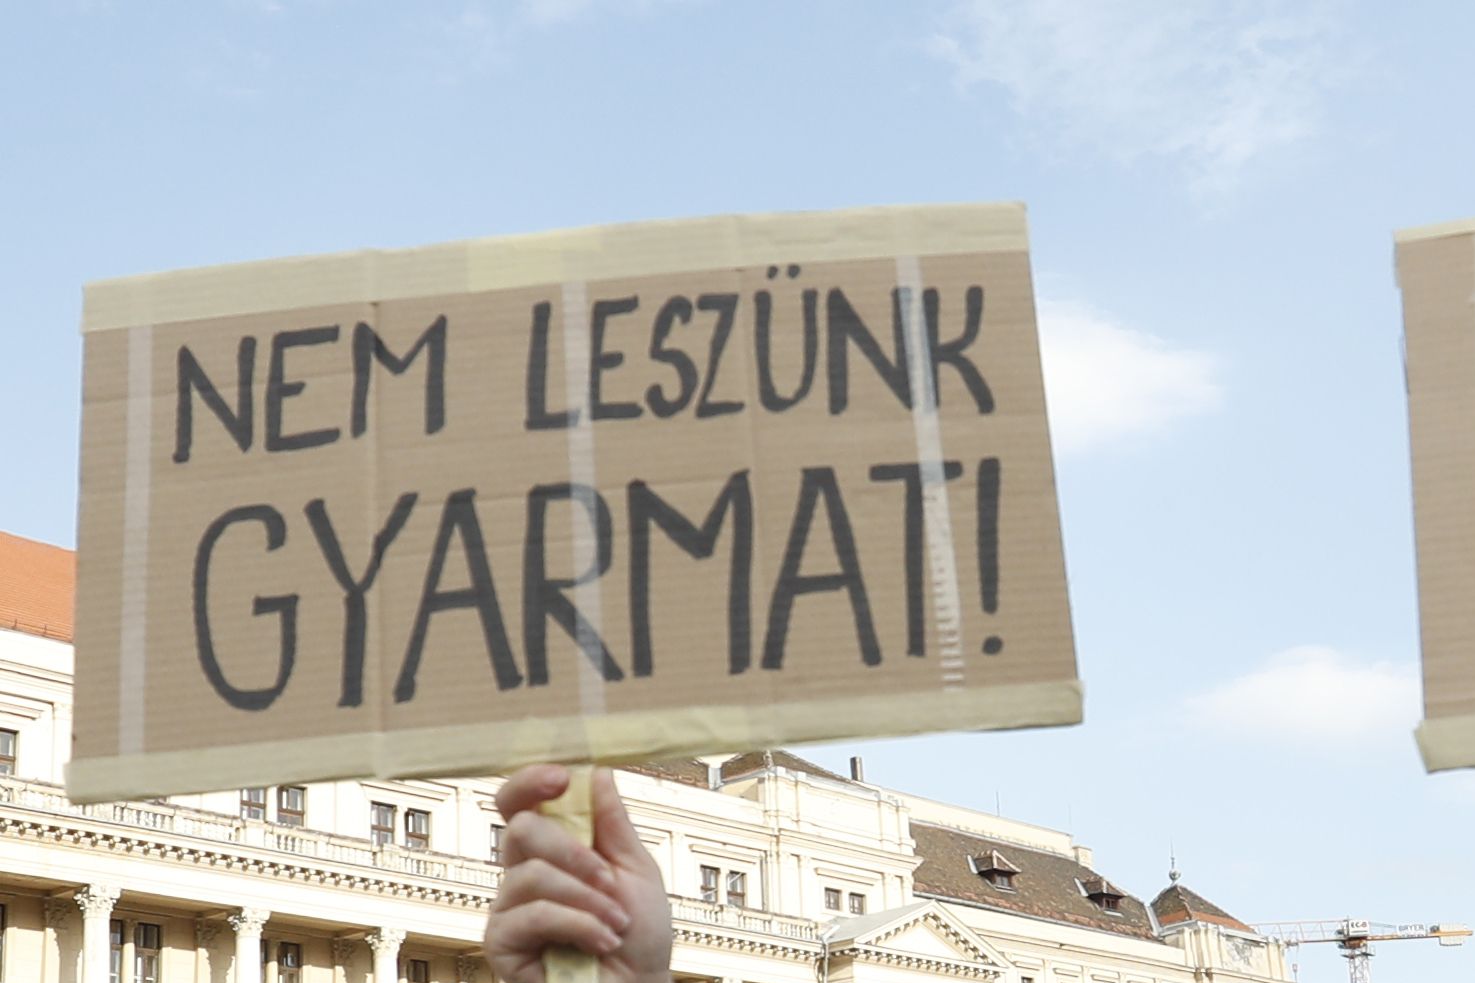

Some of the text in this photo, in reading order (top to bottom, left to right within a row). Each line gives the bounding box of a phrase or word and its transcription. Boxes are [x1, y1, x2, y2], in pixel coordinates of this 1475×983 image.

[173, 263, 995, 464] NEM LESZÜNK
[193, 457, 1004, 711] GYARMAT!
